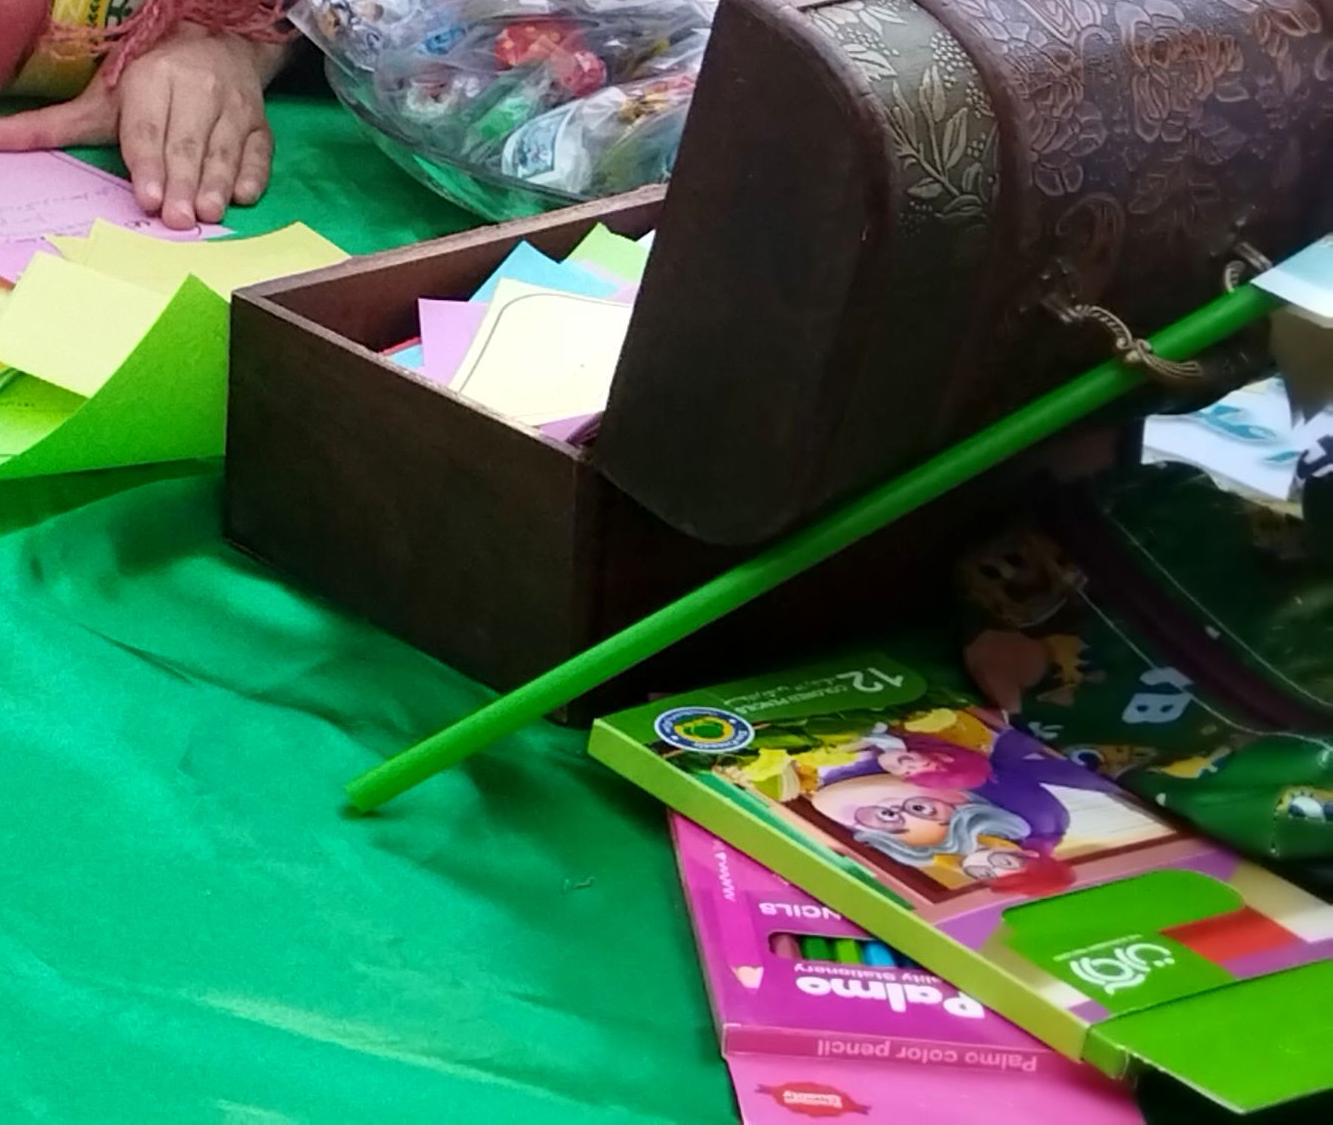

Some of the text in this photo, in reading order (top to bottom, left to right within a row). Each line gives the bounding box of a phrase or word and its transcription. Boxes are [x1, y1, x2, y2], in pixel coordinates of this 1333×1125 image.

[835, 666, 904, 693] 12
[794, 962, 897, 980] Stationery
[795, 975, 985, 1019] Palmo
[816, 1038, 1038, 1072] Palmo color pencil
